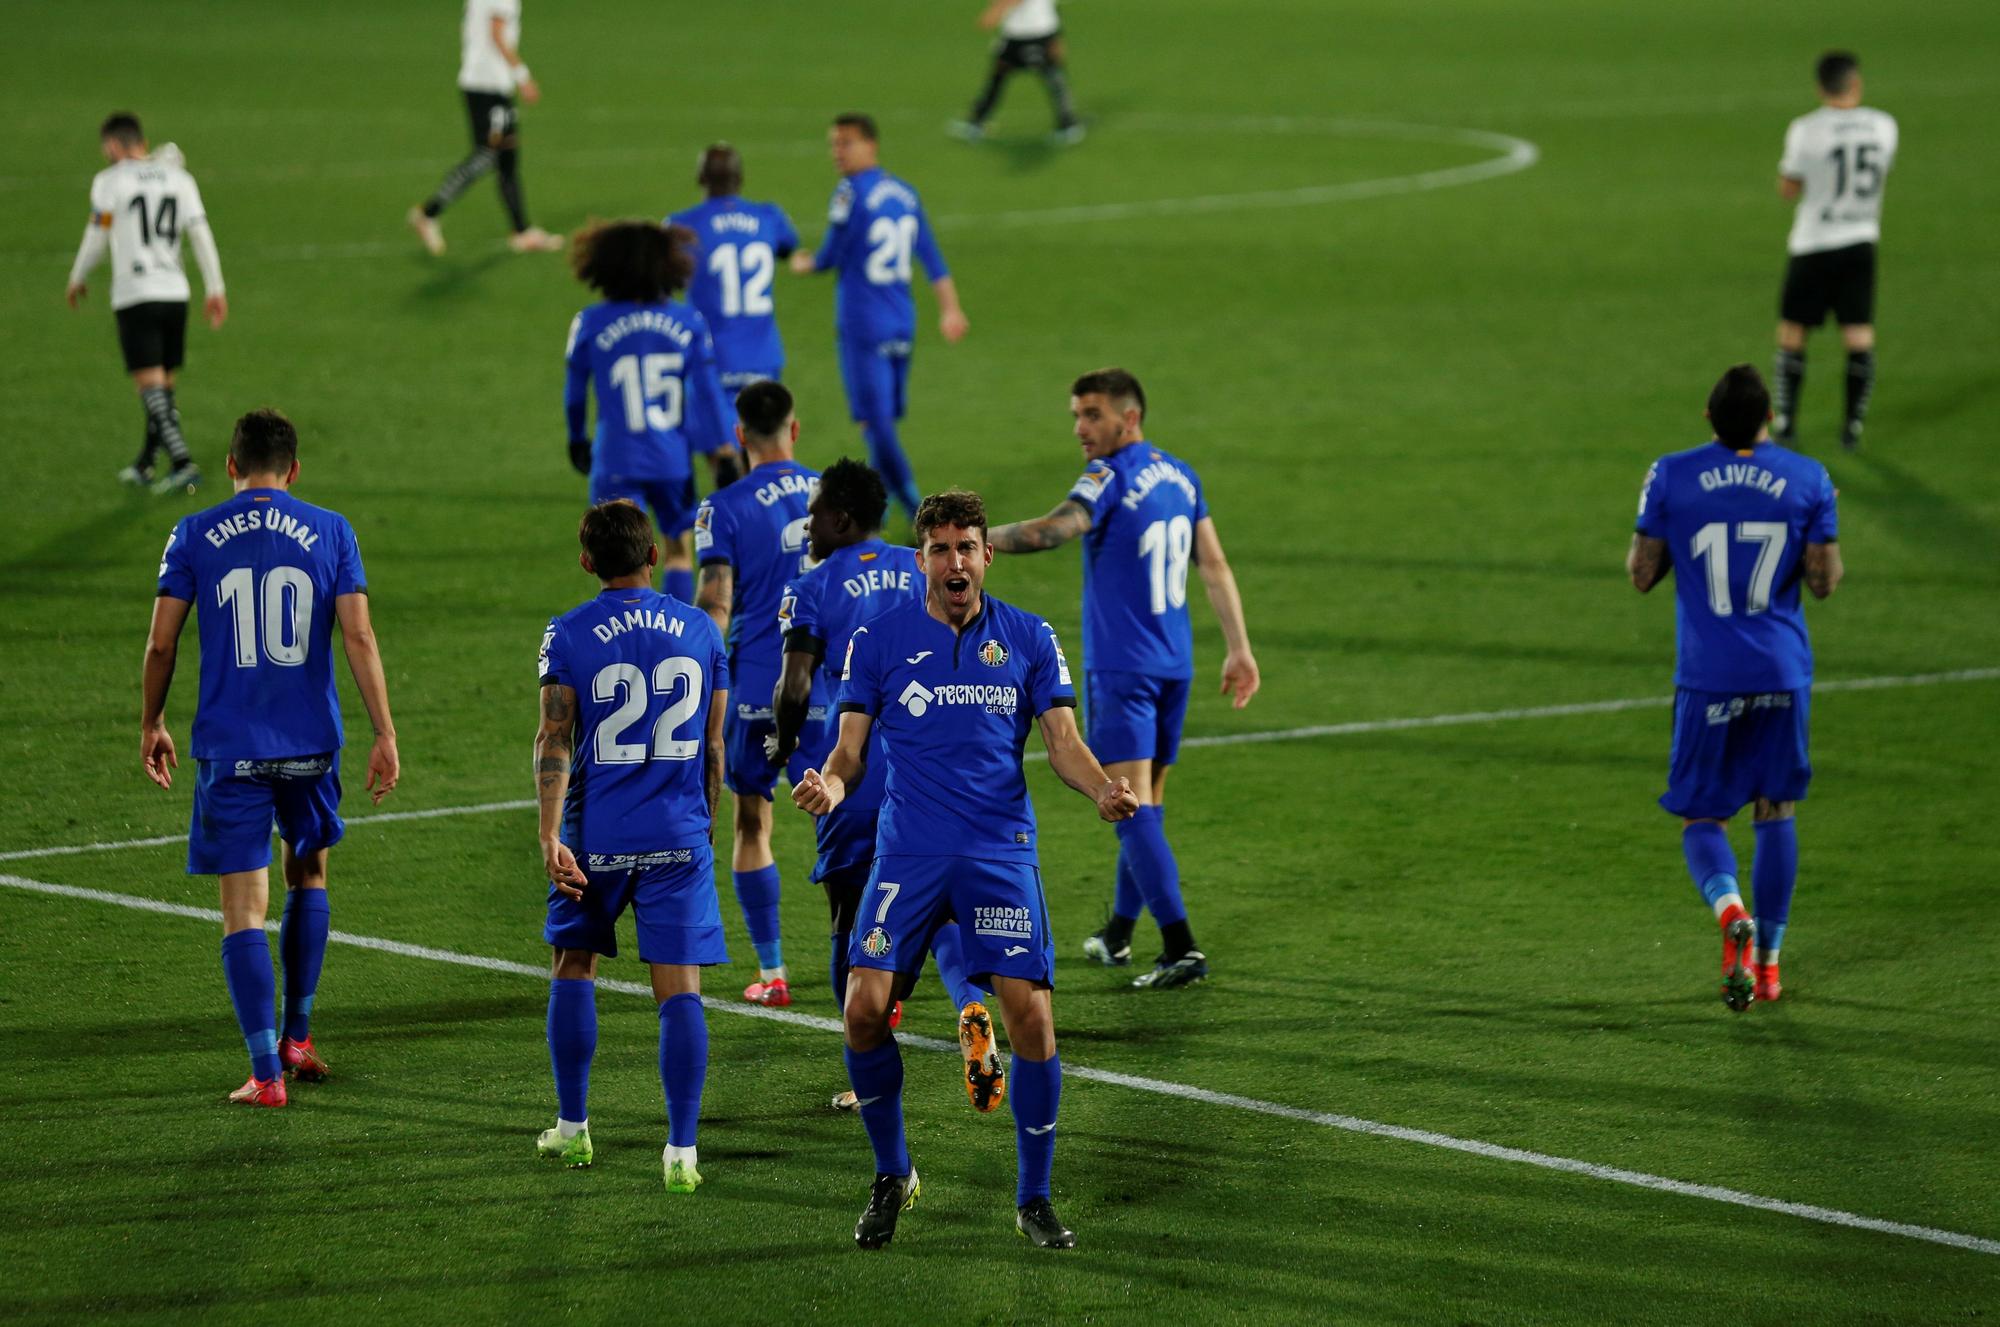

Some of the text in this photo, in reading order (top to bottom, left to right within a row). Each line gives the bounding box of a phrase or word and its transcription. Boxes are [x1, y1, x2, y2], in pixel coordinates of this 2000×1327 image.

[1827, 142, 1882, 199] 15
[129, 193, 178, 247] 14
[709, 241, 775, 317] 12
[596, 310, 693, 351] CUCURELLA
[610, 352, 684, 432] 15
[1699, 464, 1787, 499] OLIVERA
[205, 507, 319, 552] ENES ÜNAL
[843, 569, 912, 598] DJENE
[1138, 515, 1193, 615] 18
[1690, 522, 1788, 617] 17
[216, 566, 314, 668] 10
[592, 609, 685, 644] DAMIÁN
[592, 656, 703, 765] 22
[934, 685, 1017, 707] TECNOCASA
[985, 705, 1017, 715] GROUP
[874, 882, 900, 924] 7
[975, 906, 1030, 920] TEJADA'S
[975, 918, 1032, 932] FOREVER
